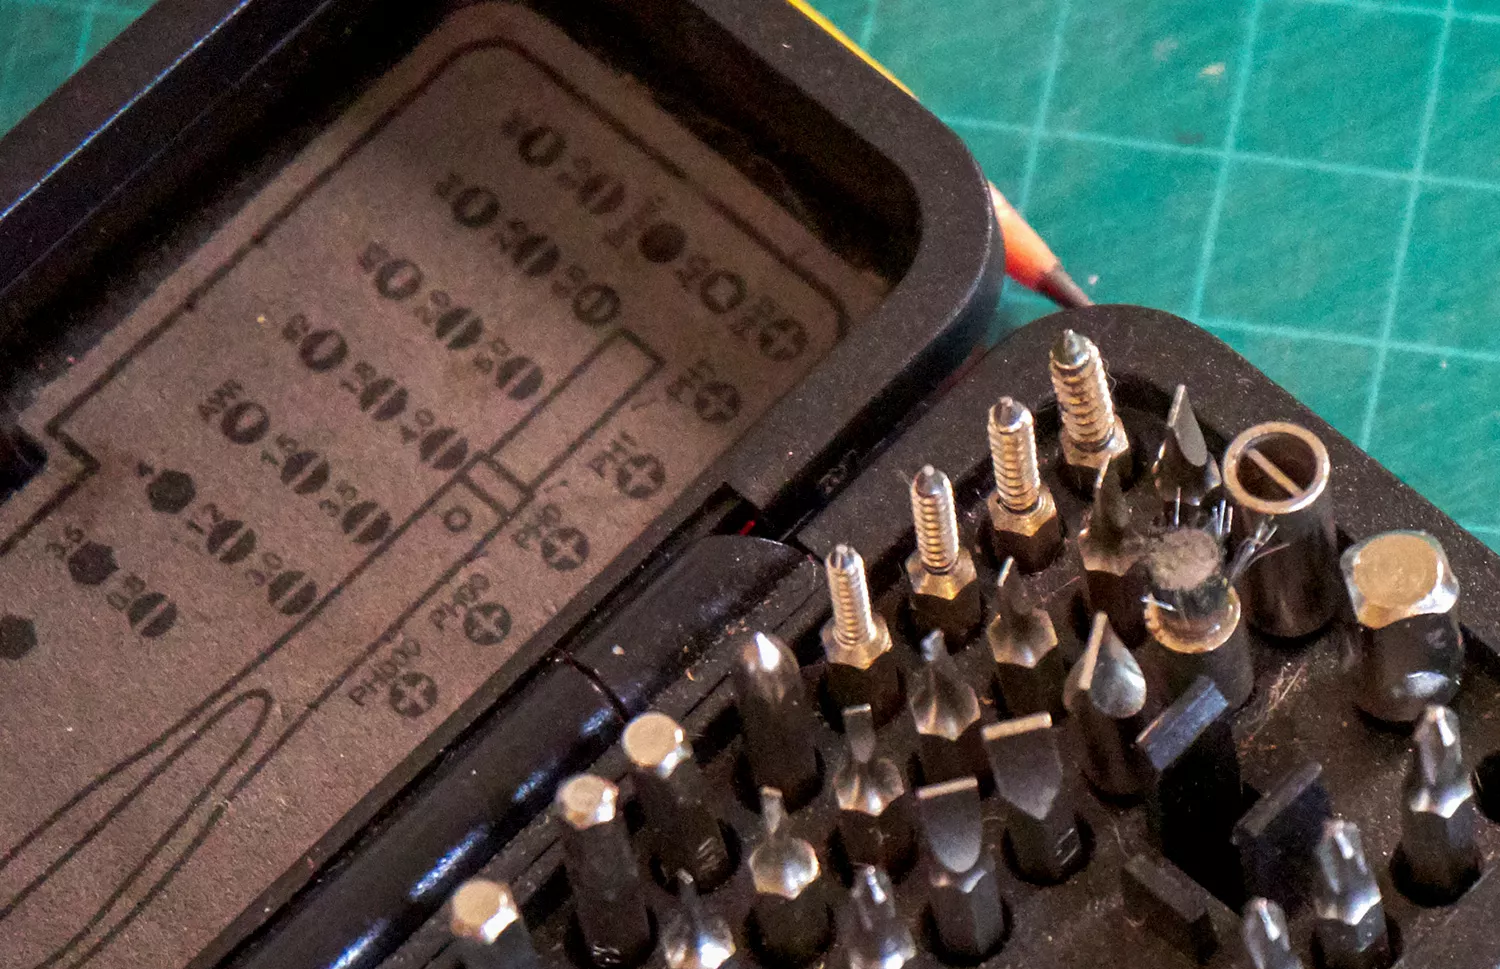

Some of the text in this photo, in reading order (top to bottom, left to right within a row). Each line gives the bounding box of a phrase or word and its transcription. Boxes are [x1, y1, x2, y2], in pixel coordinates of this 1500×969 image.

[513, 502, 563, 549] PH0
[429, 572, 490, 628] PH00
[350, 638, 423, 705] PH000
